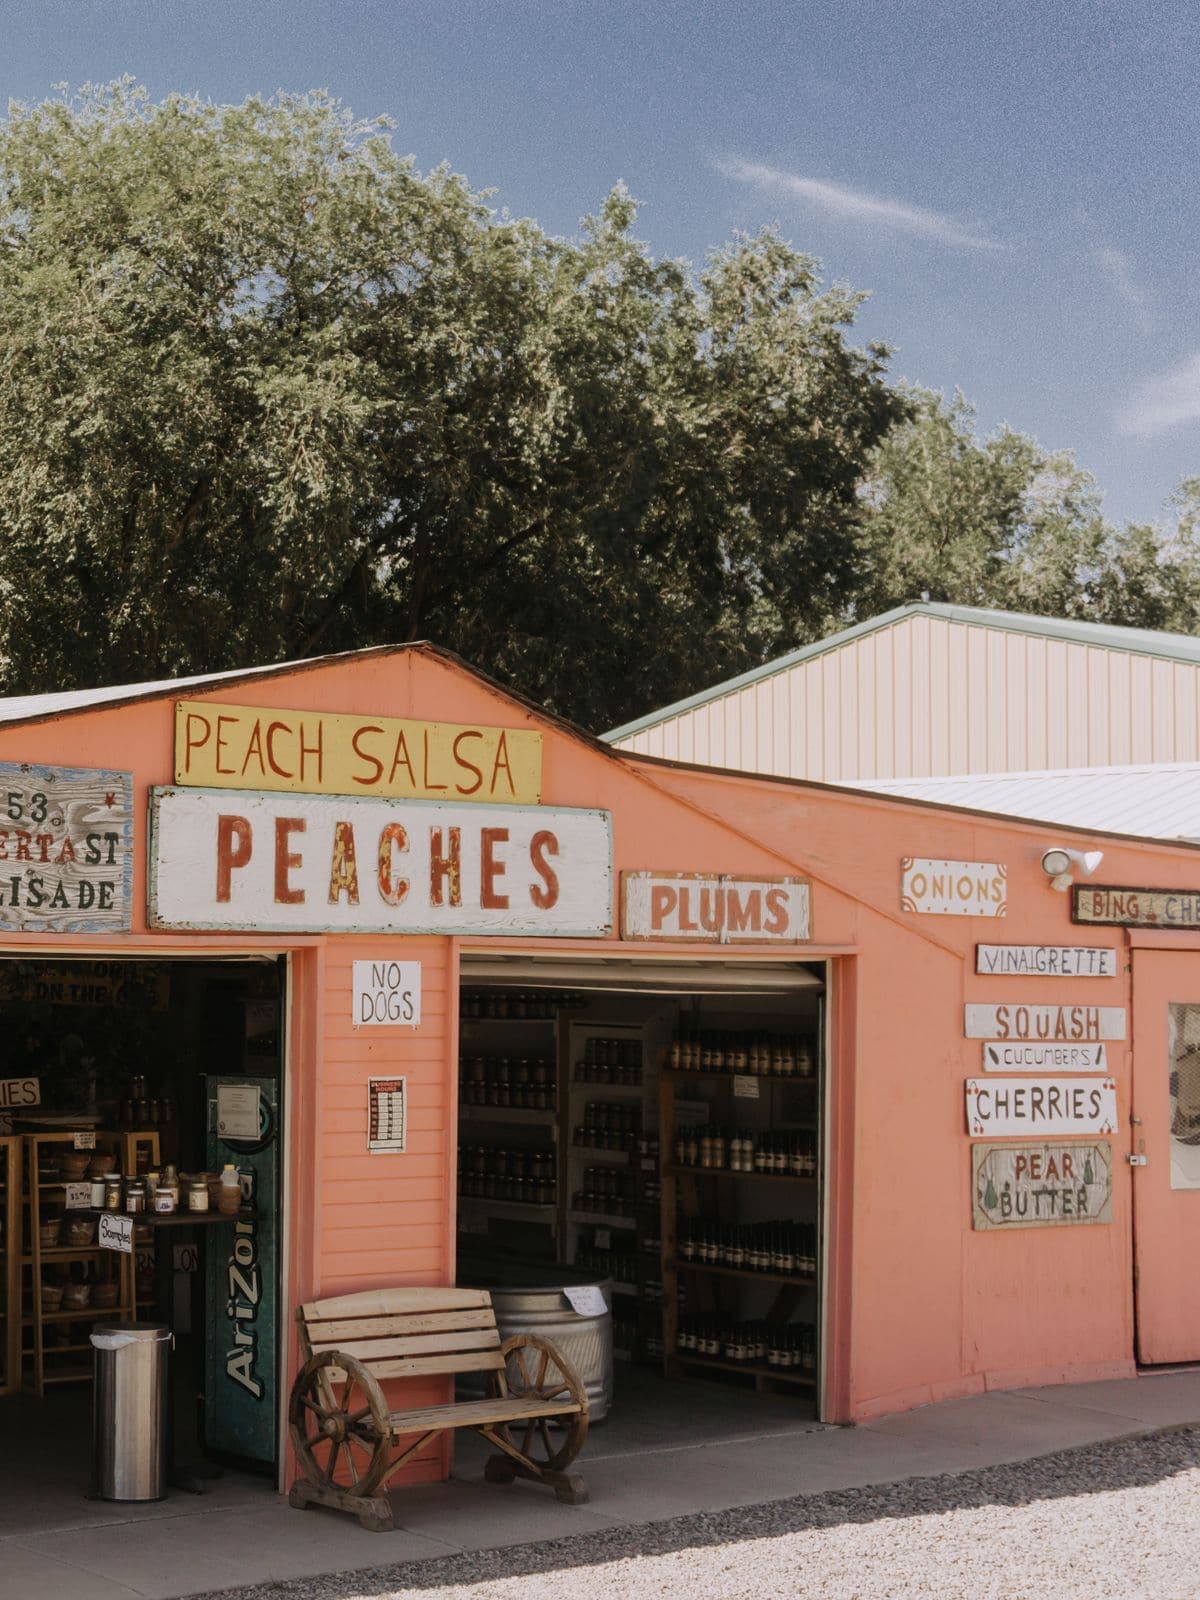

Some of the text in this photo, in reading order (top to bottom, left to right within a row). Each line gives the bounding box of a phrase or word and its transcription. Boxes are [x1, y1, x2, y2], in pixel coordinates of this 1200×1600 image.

[185, 713, 516, 796] PEACH SALSA
[85, 831, 119, 865] ST
[215, 813, 560, 911] PEACHES
[910, 872, 1003, 903] ONIONS
[650, 885, 790, 934] PLUMS
[1092, 890, 1140, 919] BING
[371, 962, 402, 990] NO
[984, 947, 1109, 974] VINAIGRETTE
[361, 990, 414, 1023] DOGS
[995, 1005, 1100, 1041] SQUASH
[1003, 1047, 1091, 1066] CUCUMBERS
[976, 1086, 1102, 1122] CHERRIES
[1015, 1152, 1074, 1182] PEAR
[1000, 1186, 1089, 1218] BUTTER
